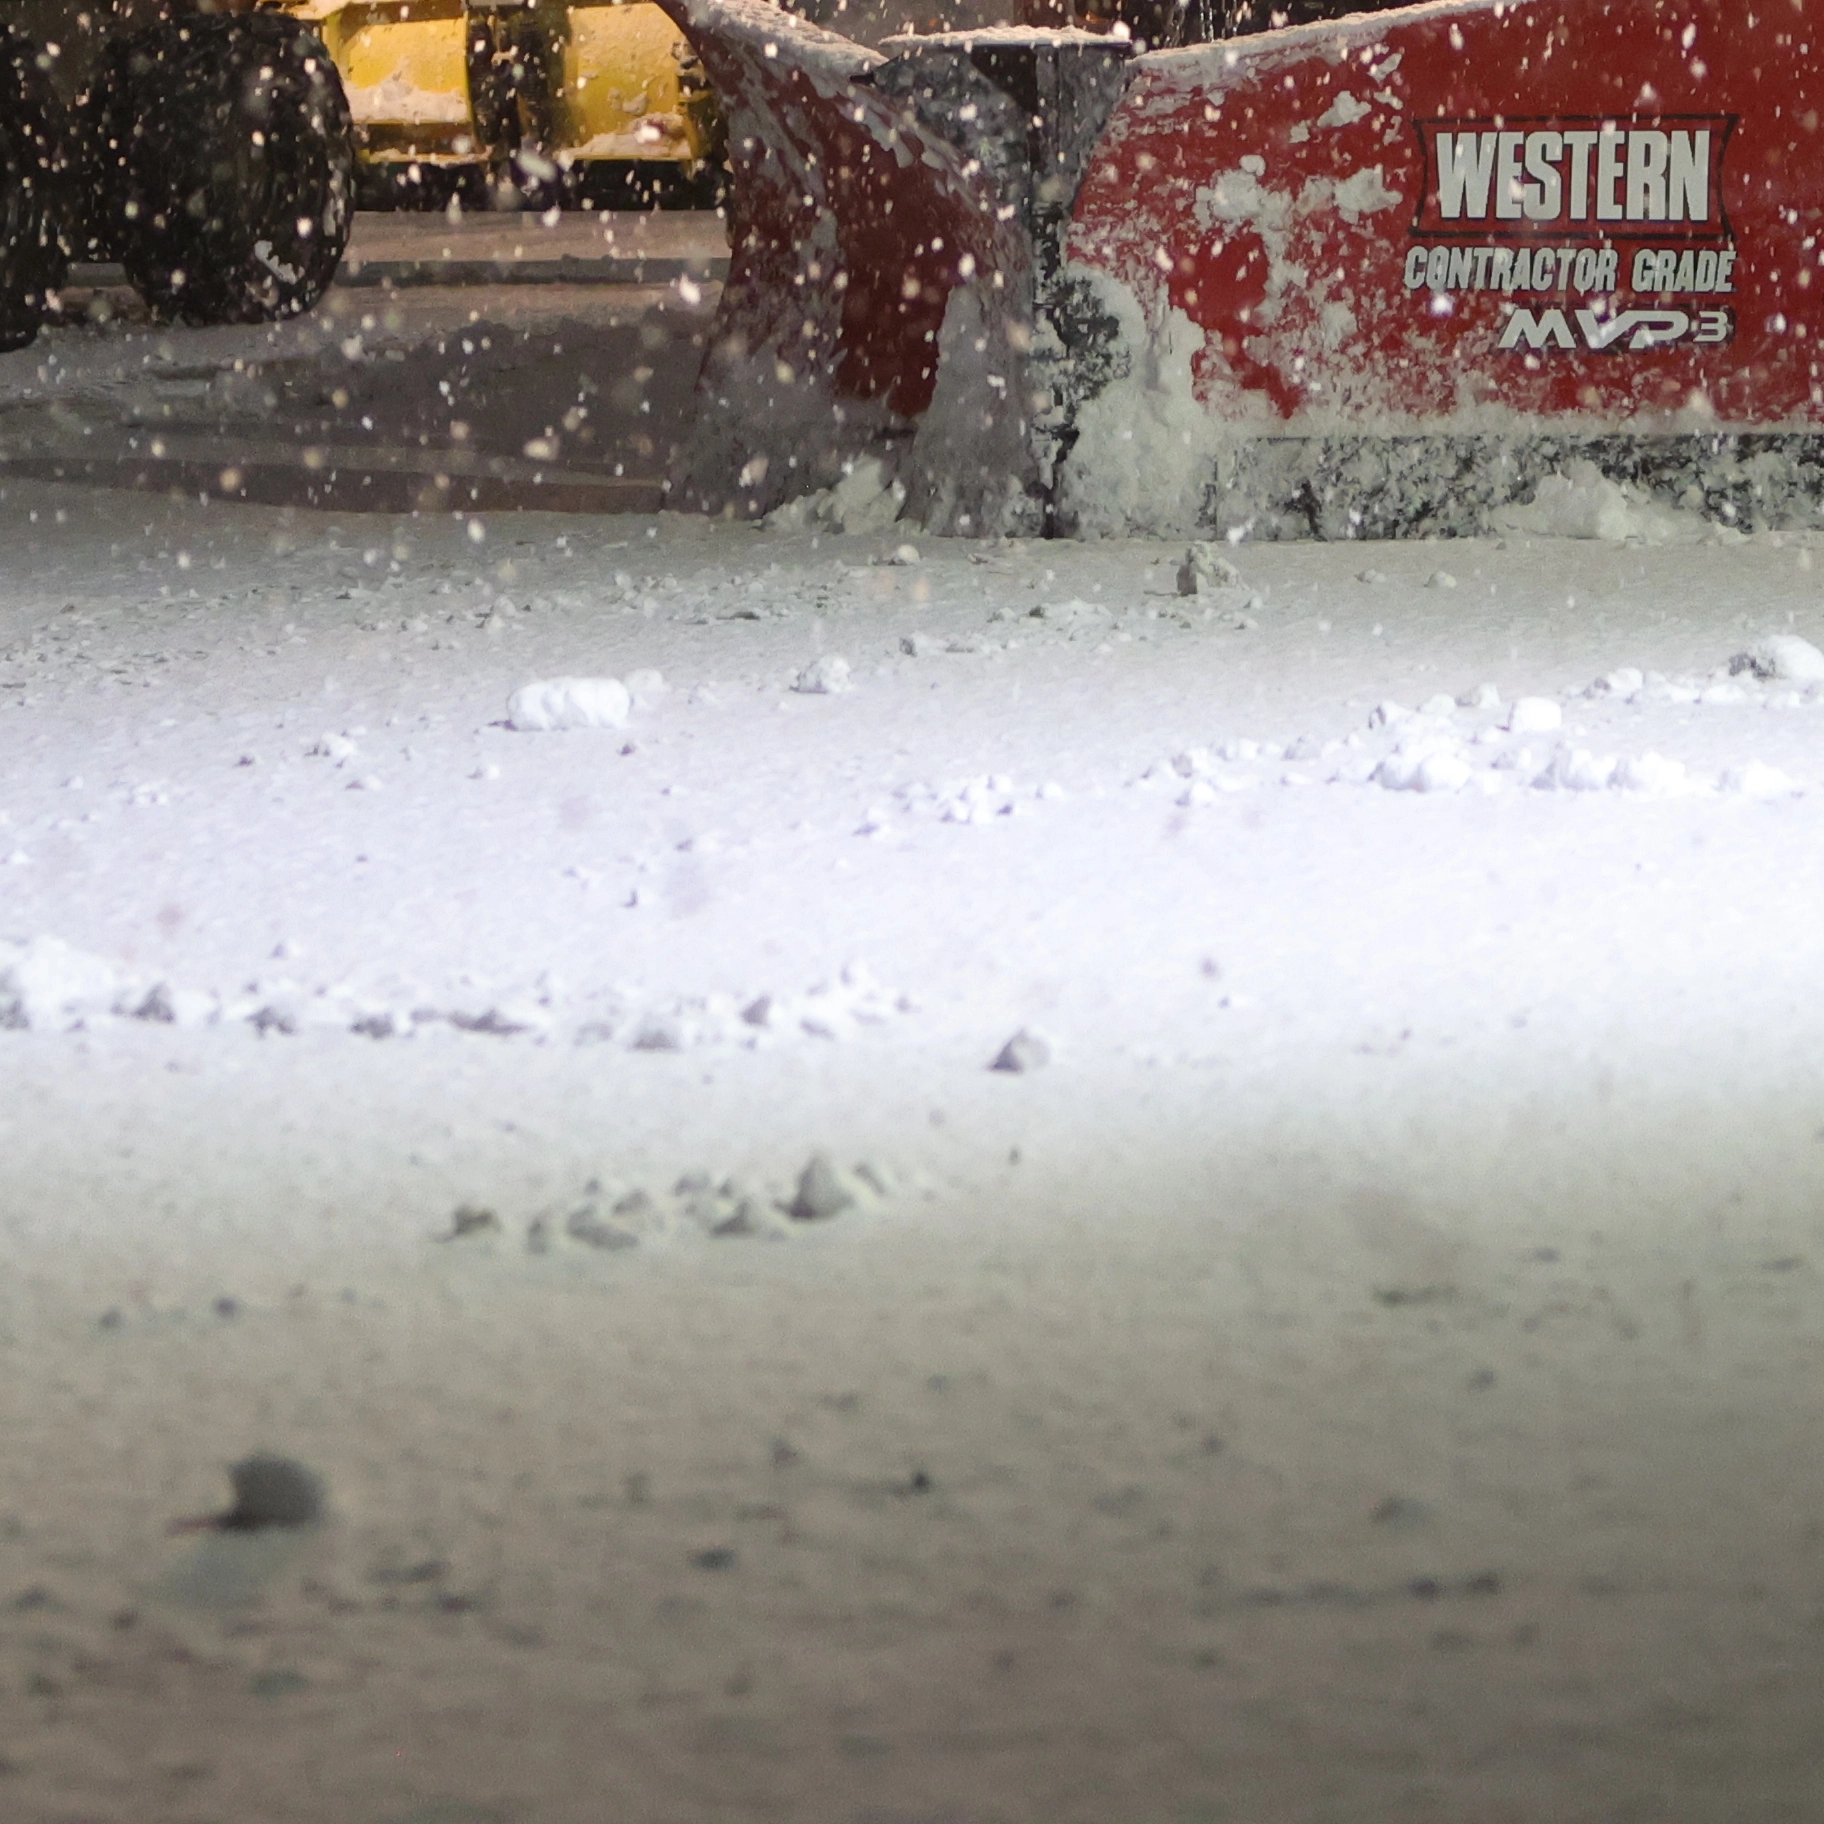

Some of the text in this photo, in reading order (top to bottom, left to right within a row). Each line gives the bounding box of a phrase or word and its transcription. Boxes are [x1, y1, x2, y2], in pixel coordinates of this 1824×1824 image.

[1435, 129, 1711, 222] WESTERN
[1404, 245, 1737, 294] CONTRACTOR GRADE
